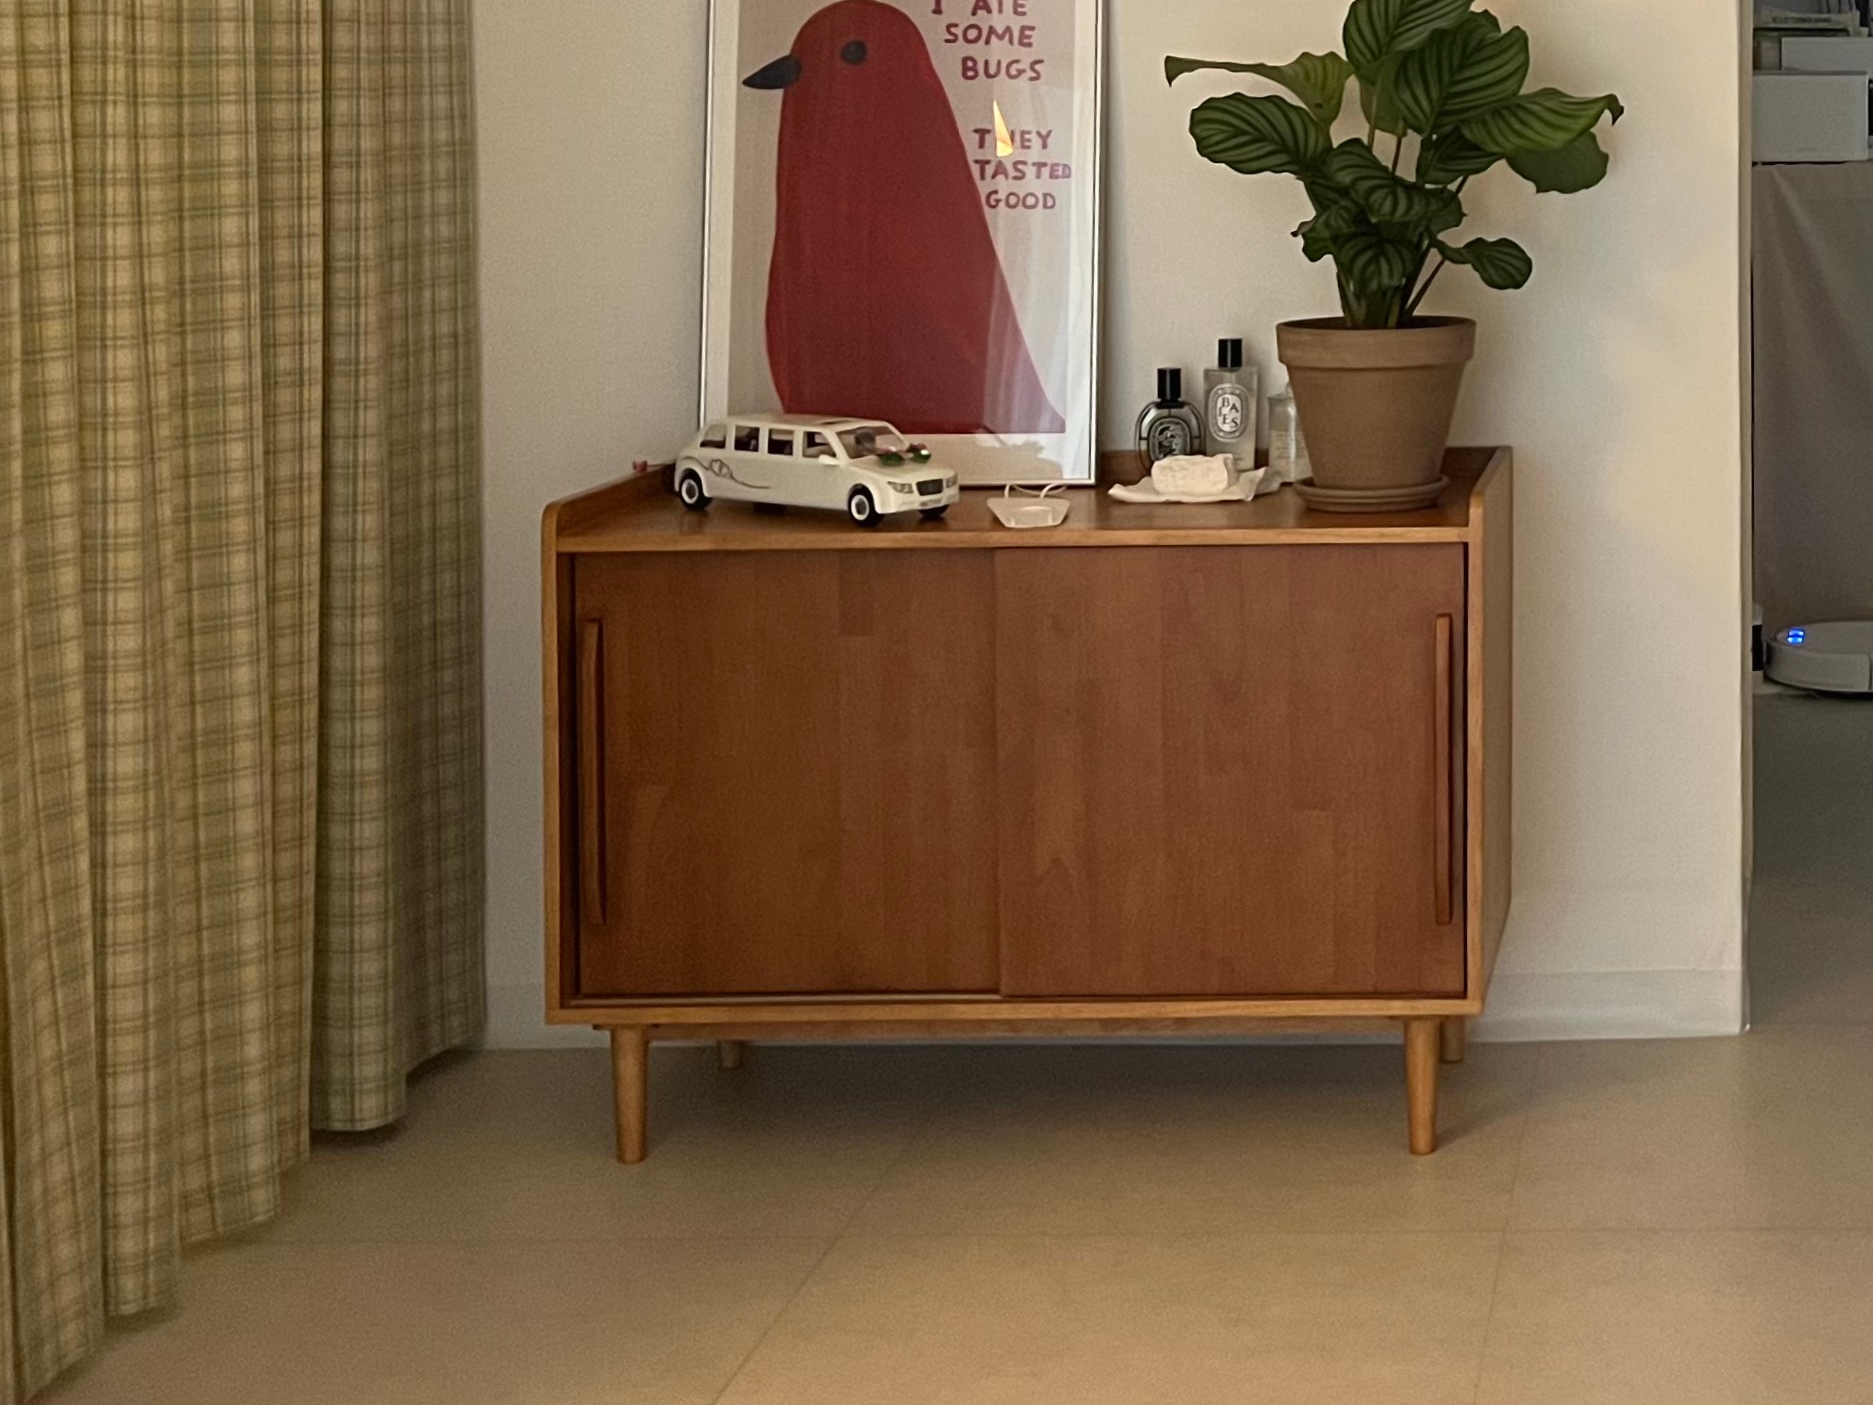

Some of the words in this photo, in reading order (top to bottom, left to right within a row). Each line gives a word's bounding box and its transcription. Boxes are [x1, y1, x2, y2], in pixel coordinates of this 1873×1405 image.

[944, 23, 1036, 48] SOME
[961, 56, 1044, 81] BUGS
[973, 159, 1072, 182] TASTED
[985, 189, 1056, 210] GOOD
